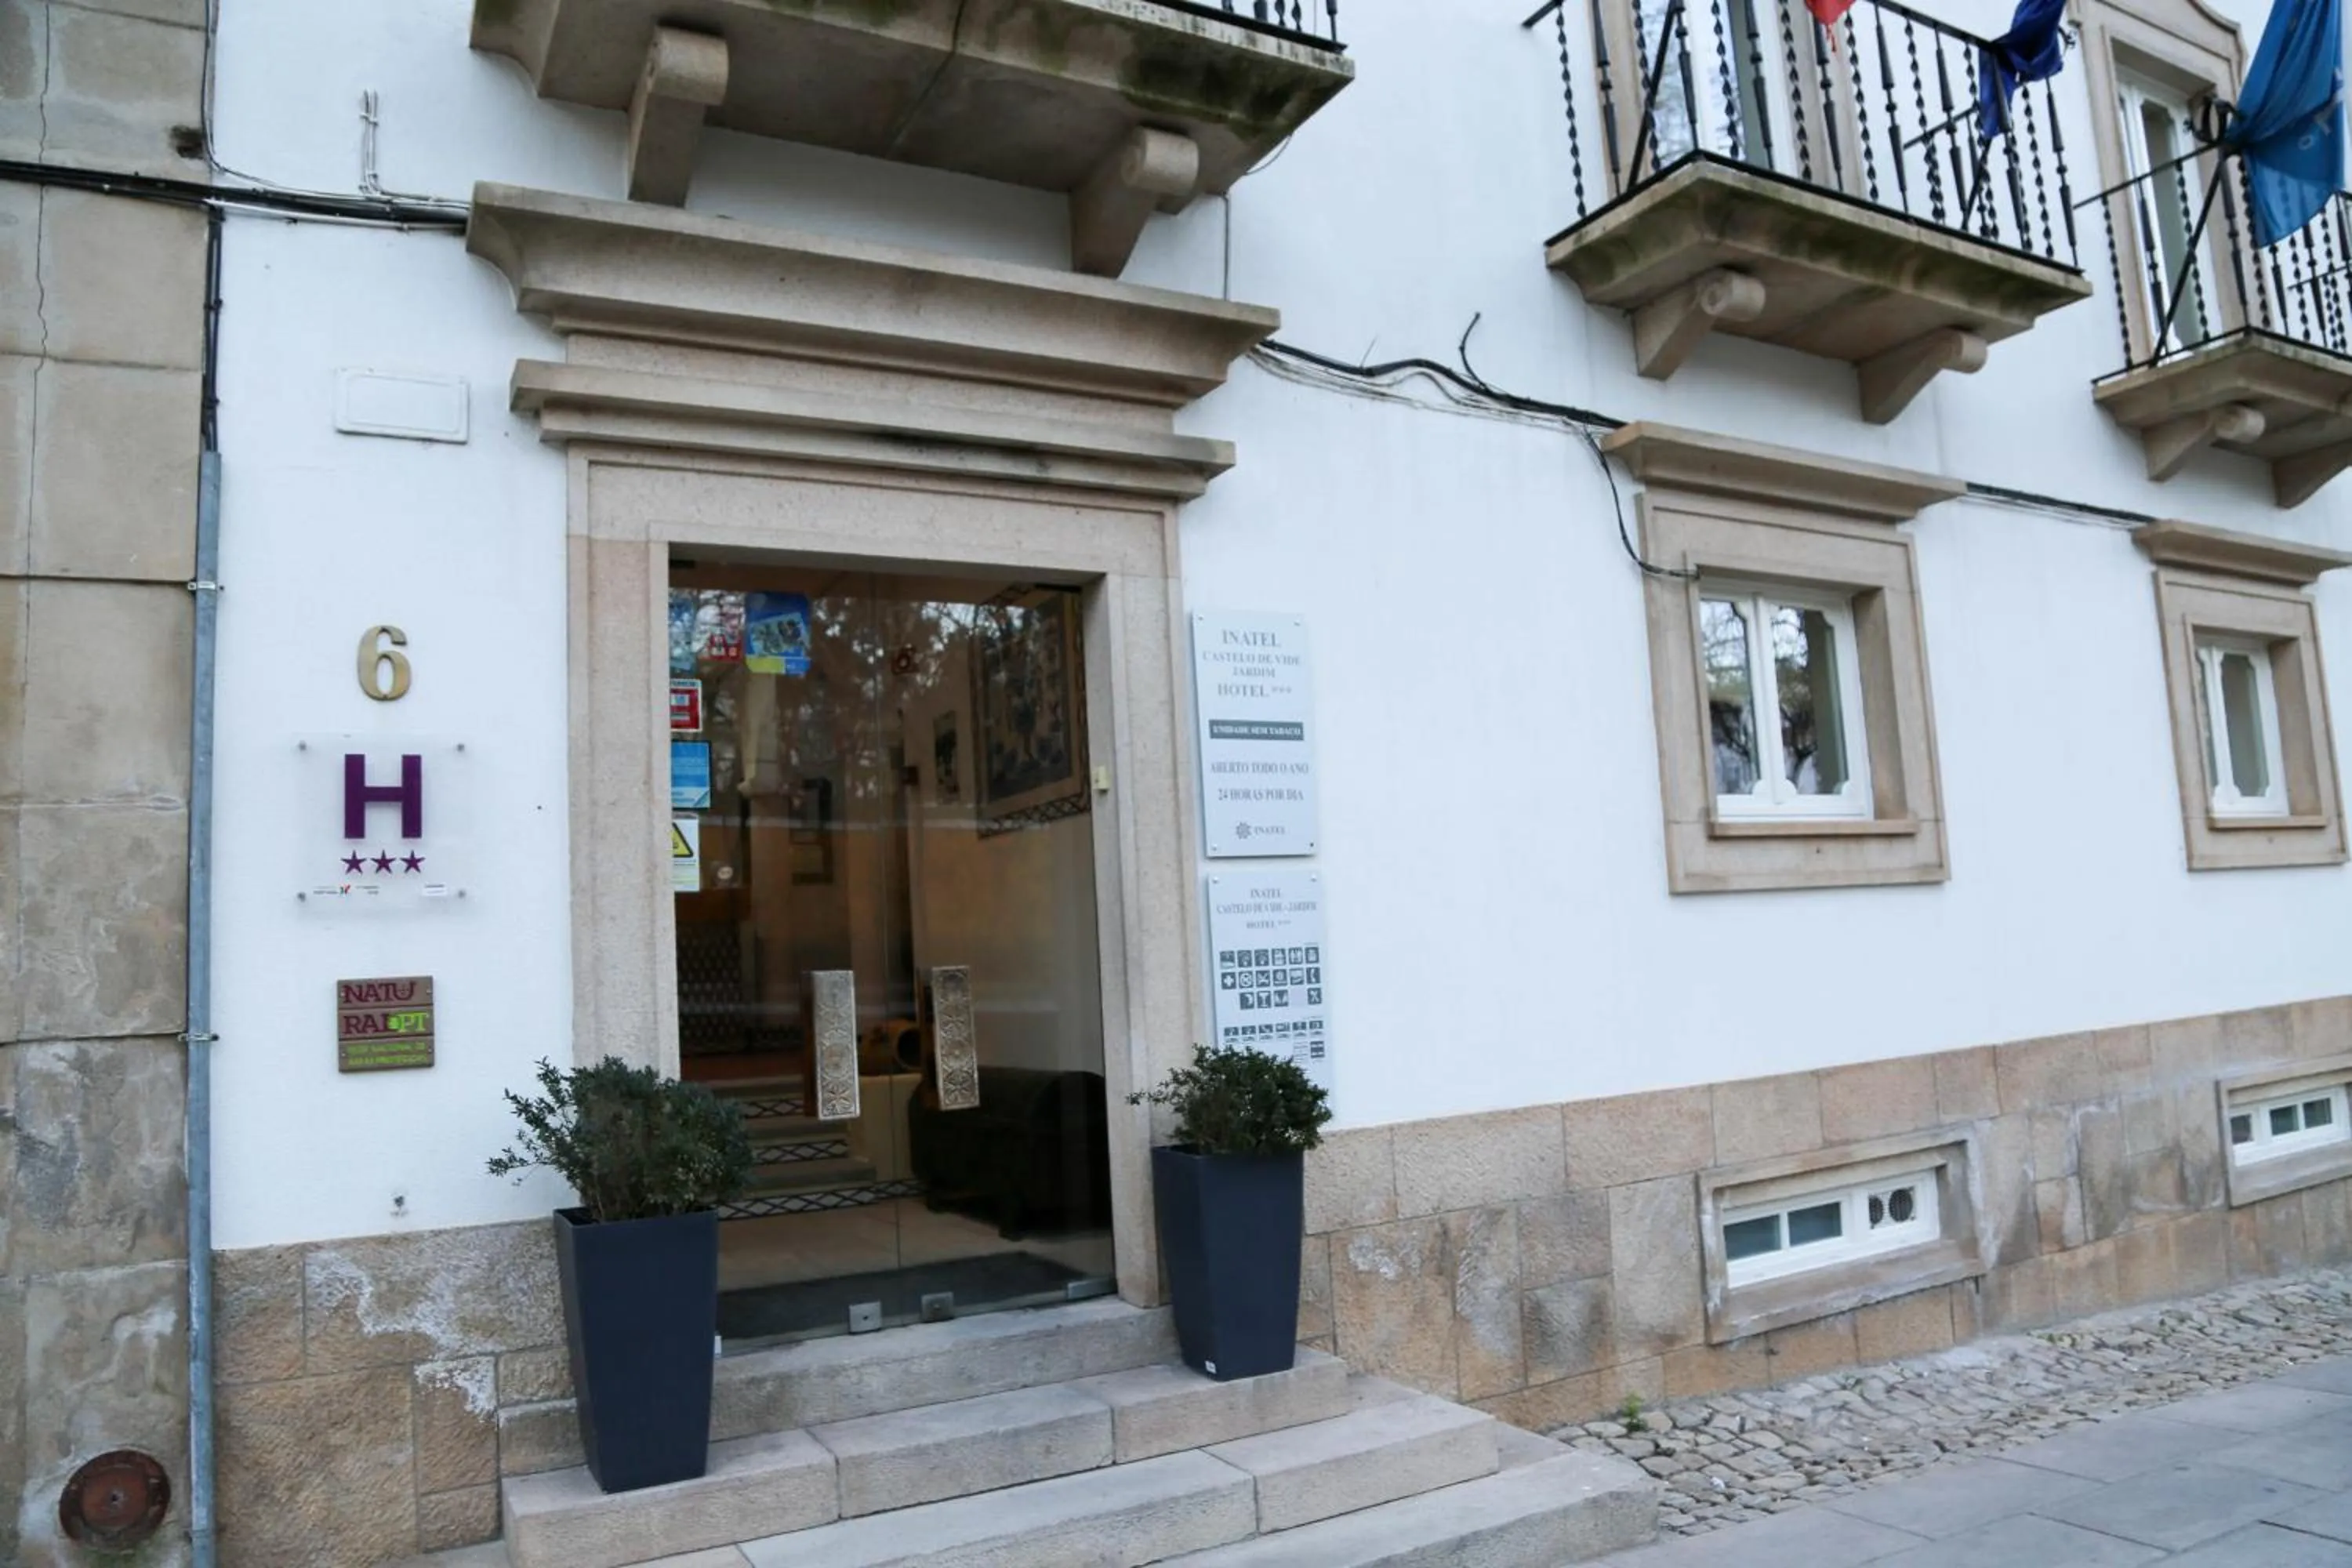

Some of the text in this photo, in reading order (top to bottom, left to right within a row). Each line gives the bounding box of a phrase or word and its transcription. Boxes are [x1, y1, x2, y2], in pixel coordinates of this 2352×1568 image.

[1222, 629, 1282, 648] INATEL
[357, 625, 412, 702] 6
[1203, 651, 1301, 666] CASTELO DE VIDE
[1232, 666, 1276, 678] JARDIM
[1218, 683, 1270, 698] HOTEL
[1210, 761, 1308, 775] ABERTO TODO O ANO
[345, 753, 422, 839] H
[1218, 788, 1305, 801] 24 HORAS POR DIA
[1254, 826, 1286, 835] INATEL
[1250, 888, 1282, 899] INATEL
[1216, 902, 1252, 914] CASTELO
[1246, 920, 1276, 930] HOTEL
[343, 980, 416, 1004] NATU
